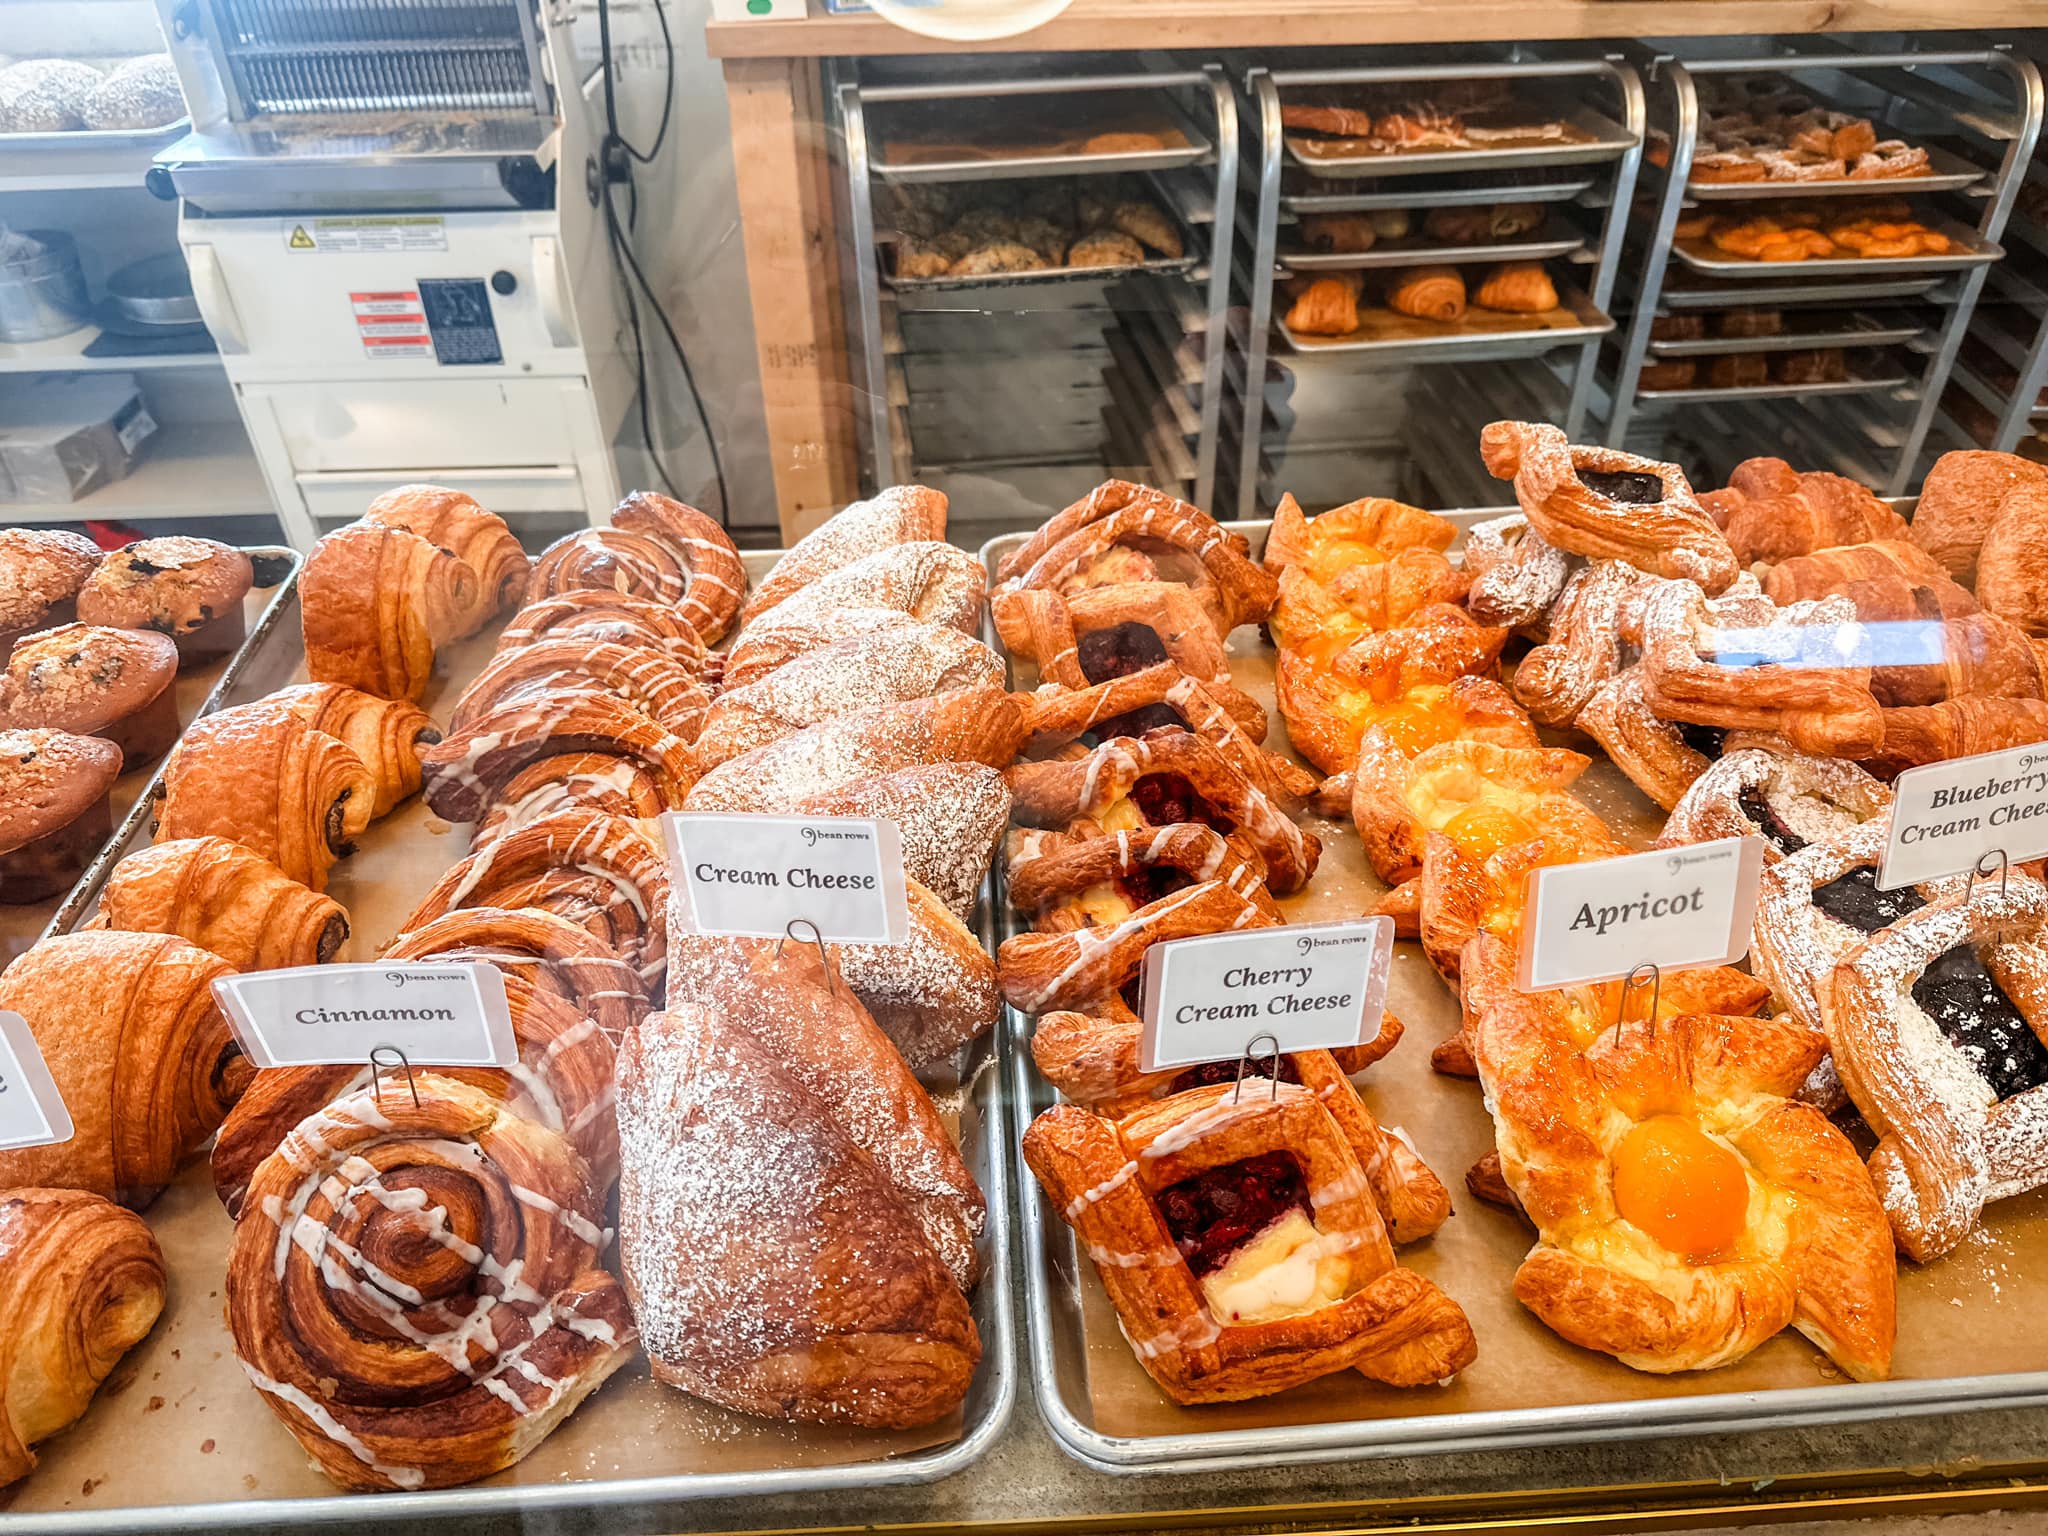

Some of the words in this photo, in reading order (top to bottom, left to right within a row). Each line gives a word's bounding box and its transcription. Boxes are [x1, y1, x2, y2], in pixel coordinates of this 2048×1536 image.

[1930, 771, 2048, 809] Blueberry
[1900, 817, 1981, 844] Cream
[1989, 802, 2048, 826] Chee
[695, 863, 780, 887] Cream
[786, 868, 876, 890] Cheese
[1569, 886, 1704, 935] Apricot
[1341, 936, 1367, 945] rows
[1223, 966, 1313, 988] Cherry
[295, 1006, 456, 1025] Cinnamon
[1176, 1003, 1259, 1024] Cream
[1267, 993, 1352, 1016] Cheese
